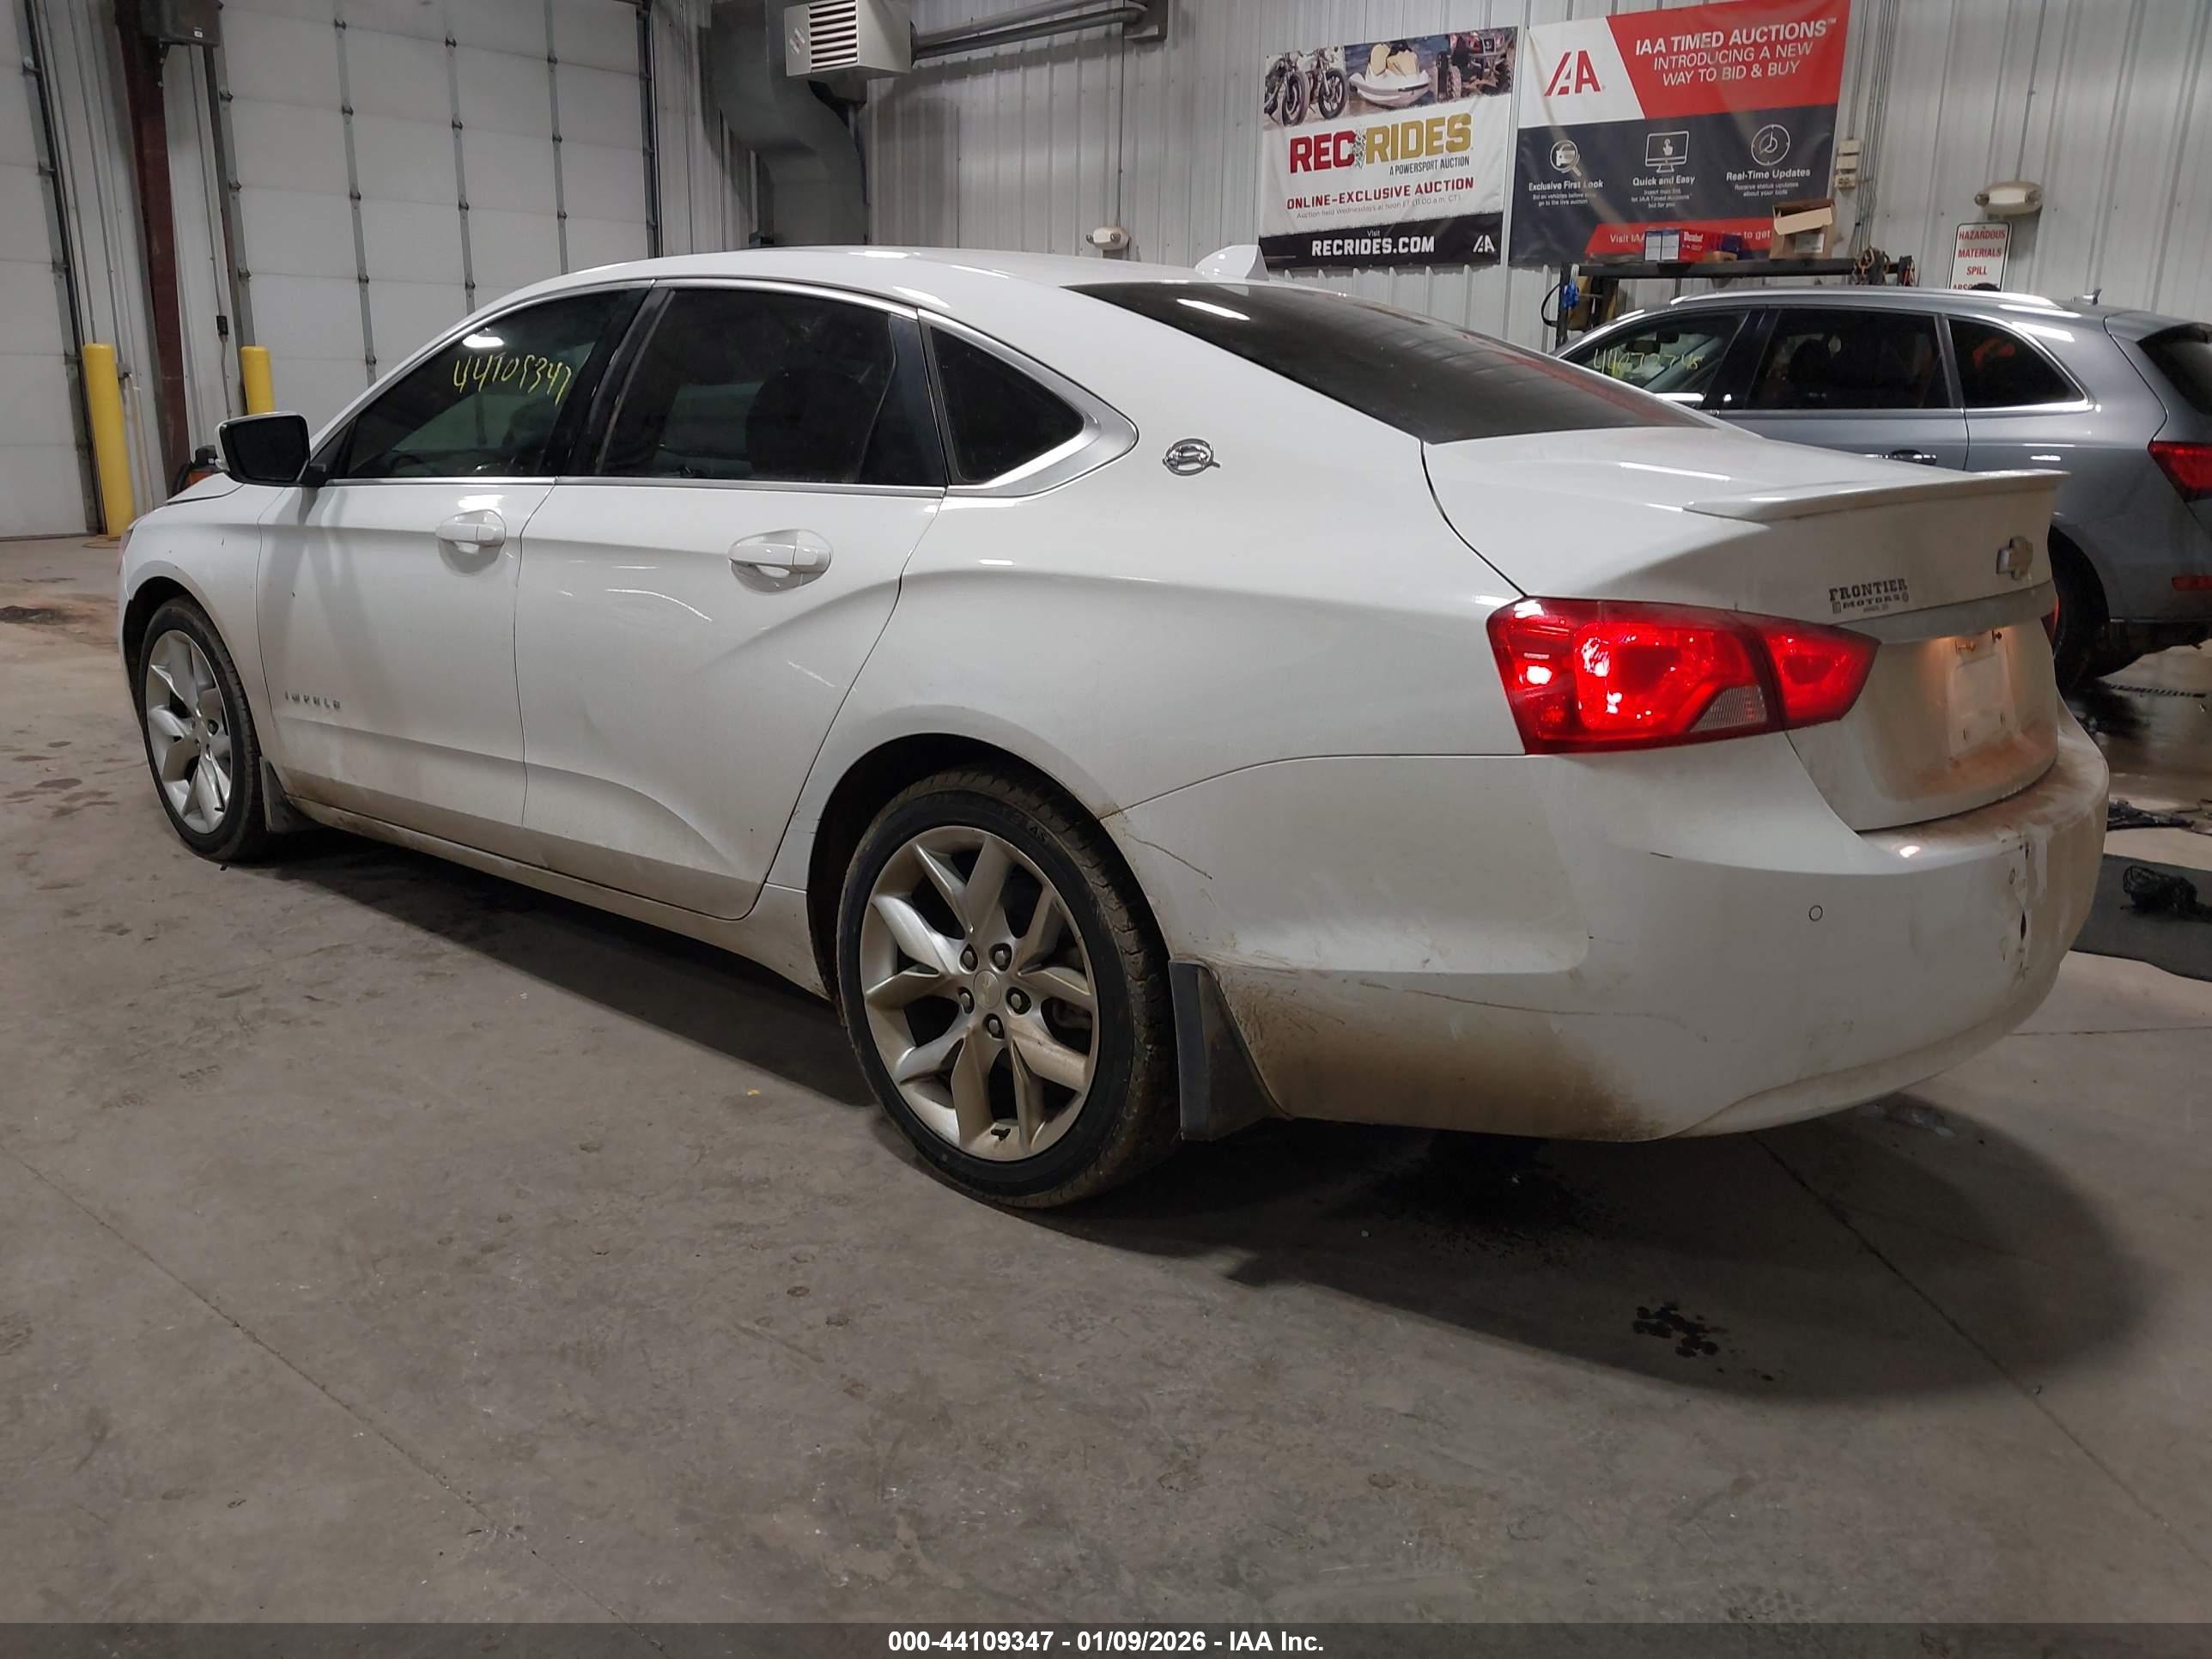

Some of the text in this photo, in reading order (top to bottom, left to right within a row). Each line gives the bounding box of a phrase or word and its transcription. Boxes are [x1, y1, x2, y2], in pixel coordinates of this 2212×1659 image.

[1636, 38, 1666, 56] IAA
[1671, 31, 1724, 52] TIMED
[1654, 41, 1814, 70] INTRODUCING A NEW
[1662, 59, 1800, 86] WAY TO BID & BUY
[1290, 112, 1472, 173] REC RIDES
[1395, 159, 1438, 175] POWERSPORT
[1440, 155, 1469, 170] AUCTION
[1632, 174, 1696, 186] Quick and Easy
[1726, 167, 1811, 181] Real-Time Updates
[1287, 177, 1474, 210] ONLINE-EXCLUSIVE AUCTION
[1528, 179, 1604, 191] Exclusive First Look
[1610, 233, 1629, 243] Visit
[1755, 229, 1771, 240] get
[1959, 229, 2006, 240] HAZARDOUS
[1312, 235, 1435, 256] RECRIDES.COM
[1958, 246, 2002, 258] MATERIALS
[1966, 265, 1987, 276] SPILL
[1829, 578, 1908, 601] FRONTIER
